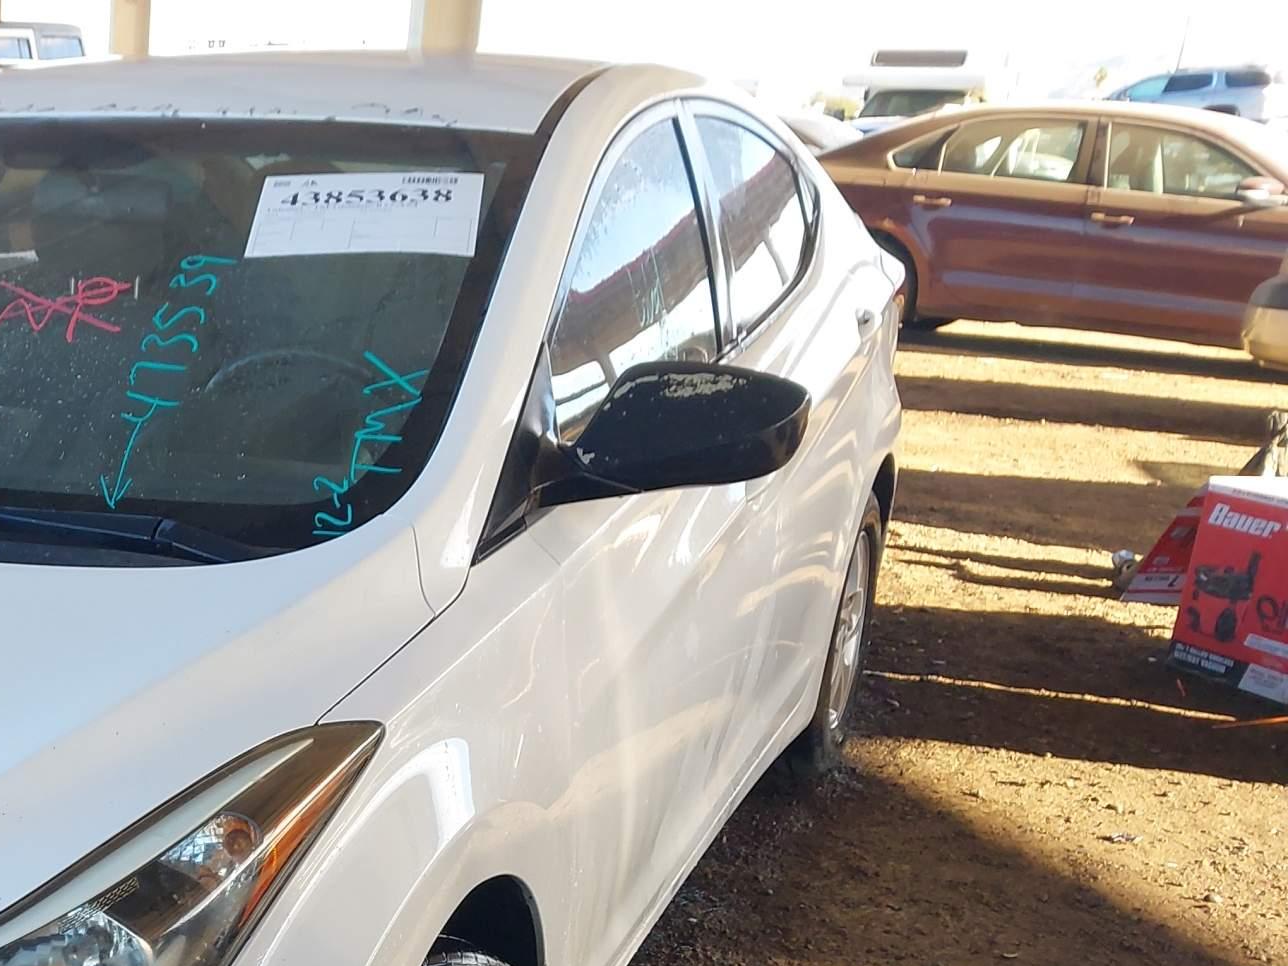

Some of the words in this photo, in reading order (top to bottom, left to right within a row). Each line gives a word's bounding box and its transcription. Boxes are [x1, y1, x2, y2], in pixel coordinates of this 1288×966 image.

[280, 187, 454, 207] 43853638
[349, 350, 430, 483] TMX
[1207, 502, 1283, 538] Bauer
